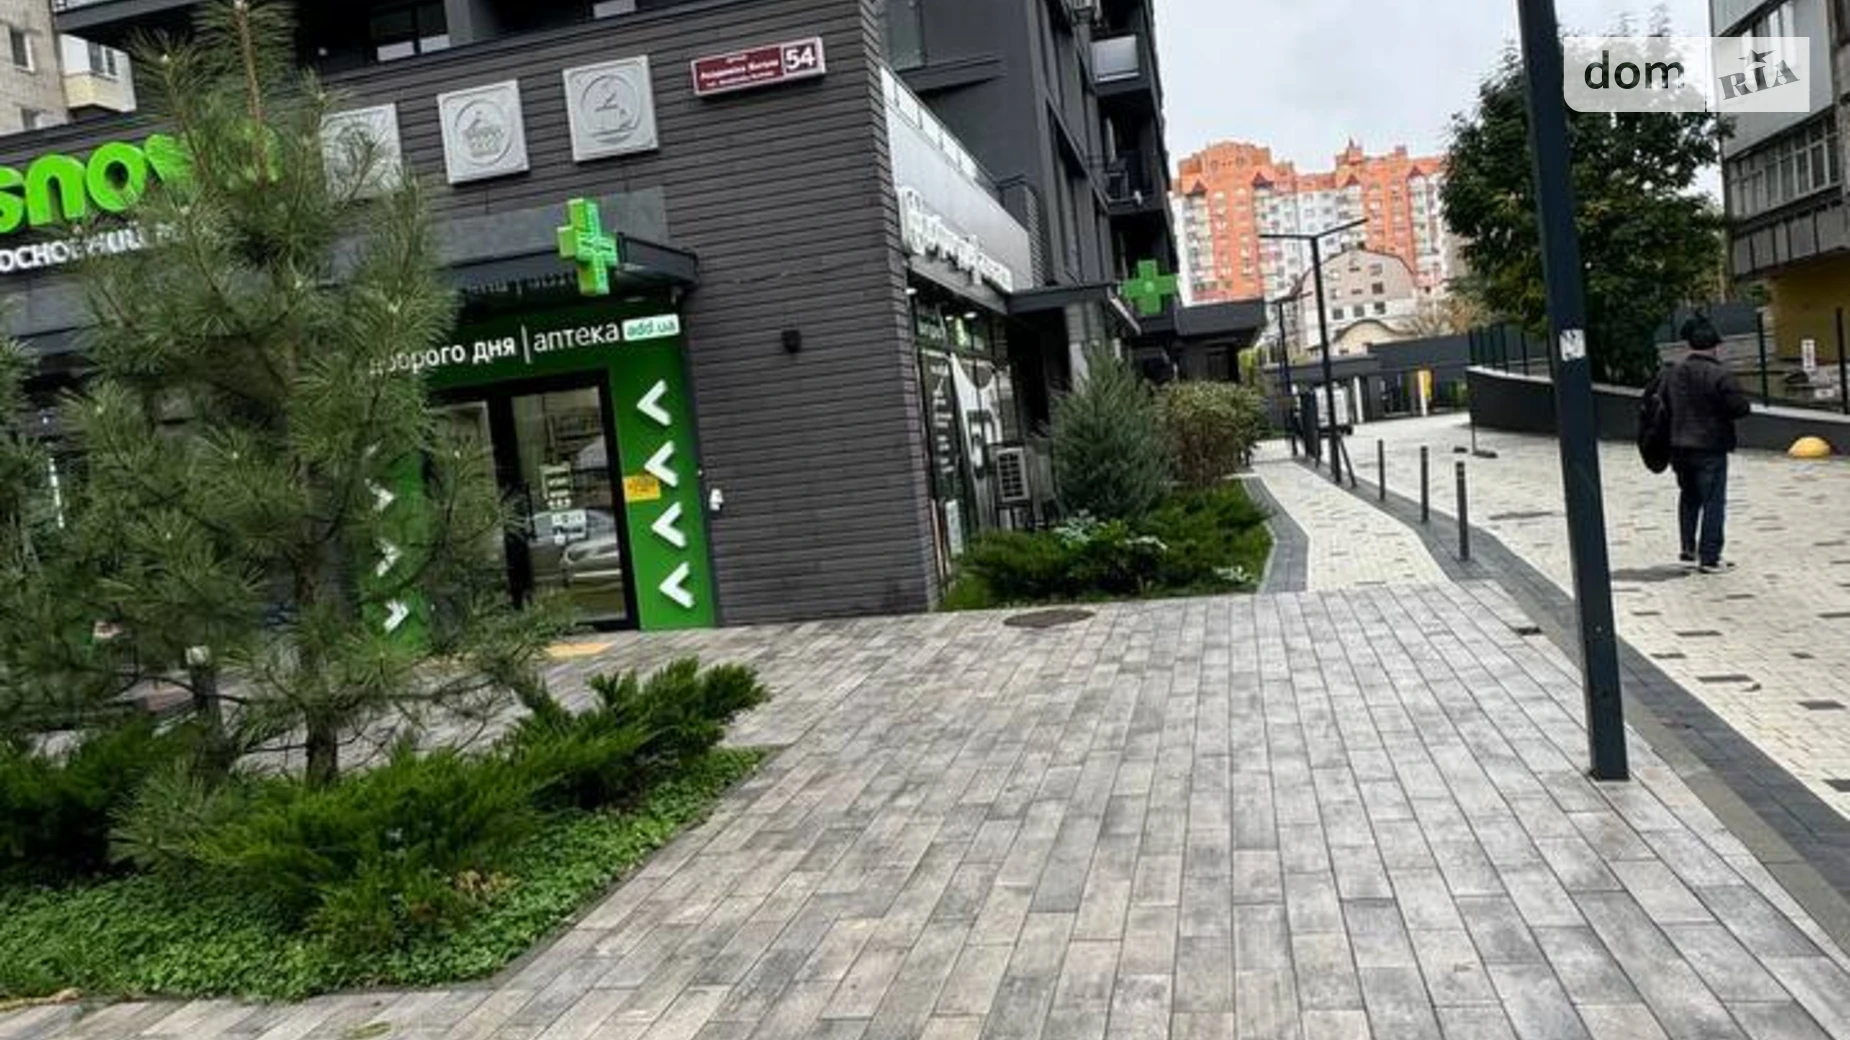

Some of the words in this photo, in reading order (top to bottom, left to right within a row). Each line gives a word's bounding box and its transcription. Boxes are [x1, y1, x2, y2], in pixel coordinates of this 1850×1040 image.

[784, 46, 816, 70] 54
[472, 335, 516, 364] дня
[533, 321, 620, 353] аптека
[626, 319, 677, 337] add.ua
